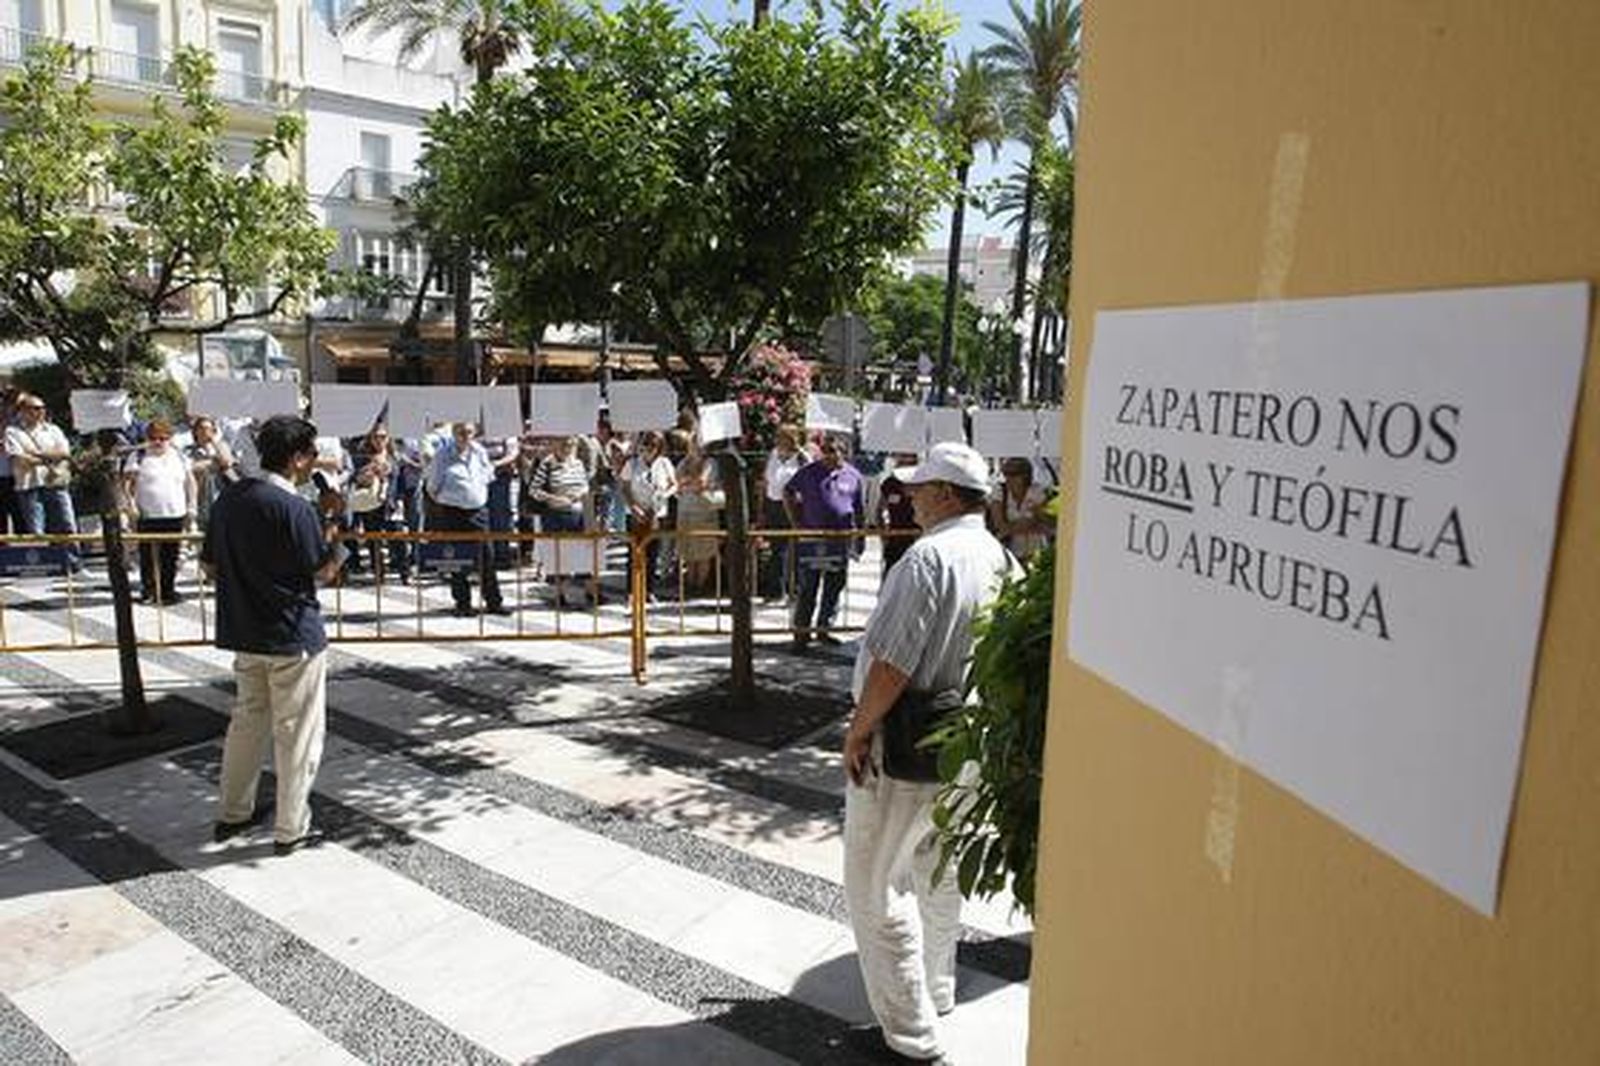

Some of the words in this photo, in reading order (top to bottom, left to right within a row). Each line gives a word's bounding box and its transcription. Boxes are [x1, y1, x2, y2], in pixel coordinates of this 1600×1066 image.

[1117, 384, 1320, 447] ZAPATERO
[1336, 398, 1461, 465] NOS
[1102, 446, 1193, 502] ROBA
[1208, 463, 1235, 507] Y
[1246, 465, 1476, 568] TEÓFILA
[1126, 514, 1169, 562] LO
[1177, 530, 1391, 641] APRUEBA
